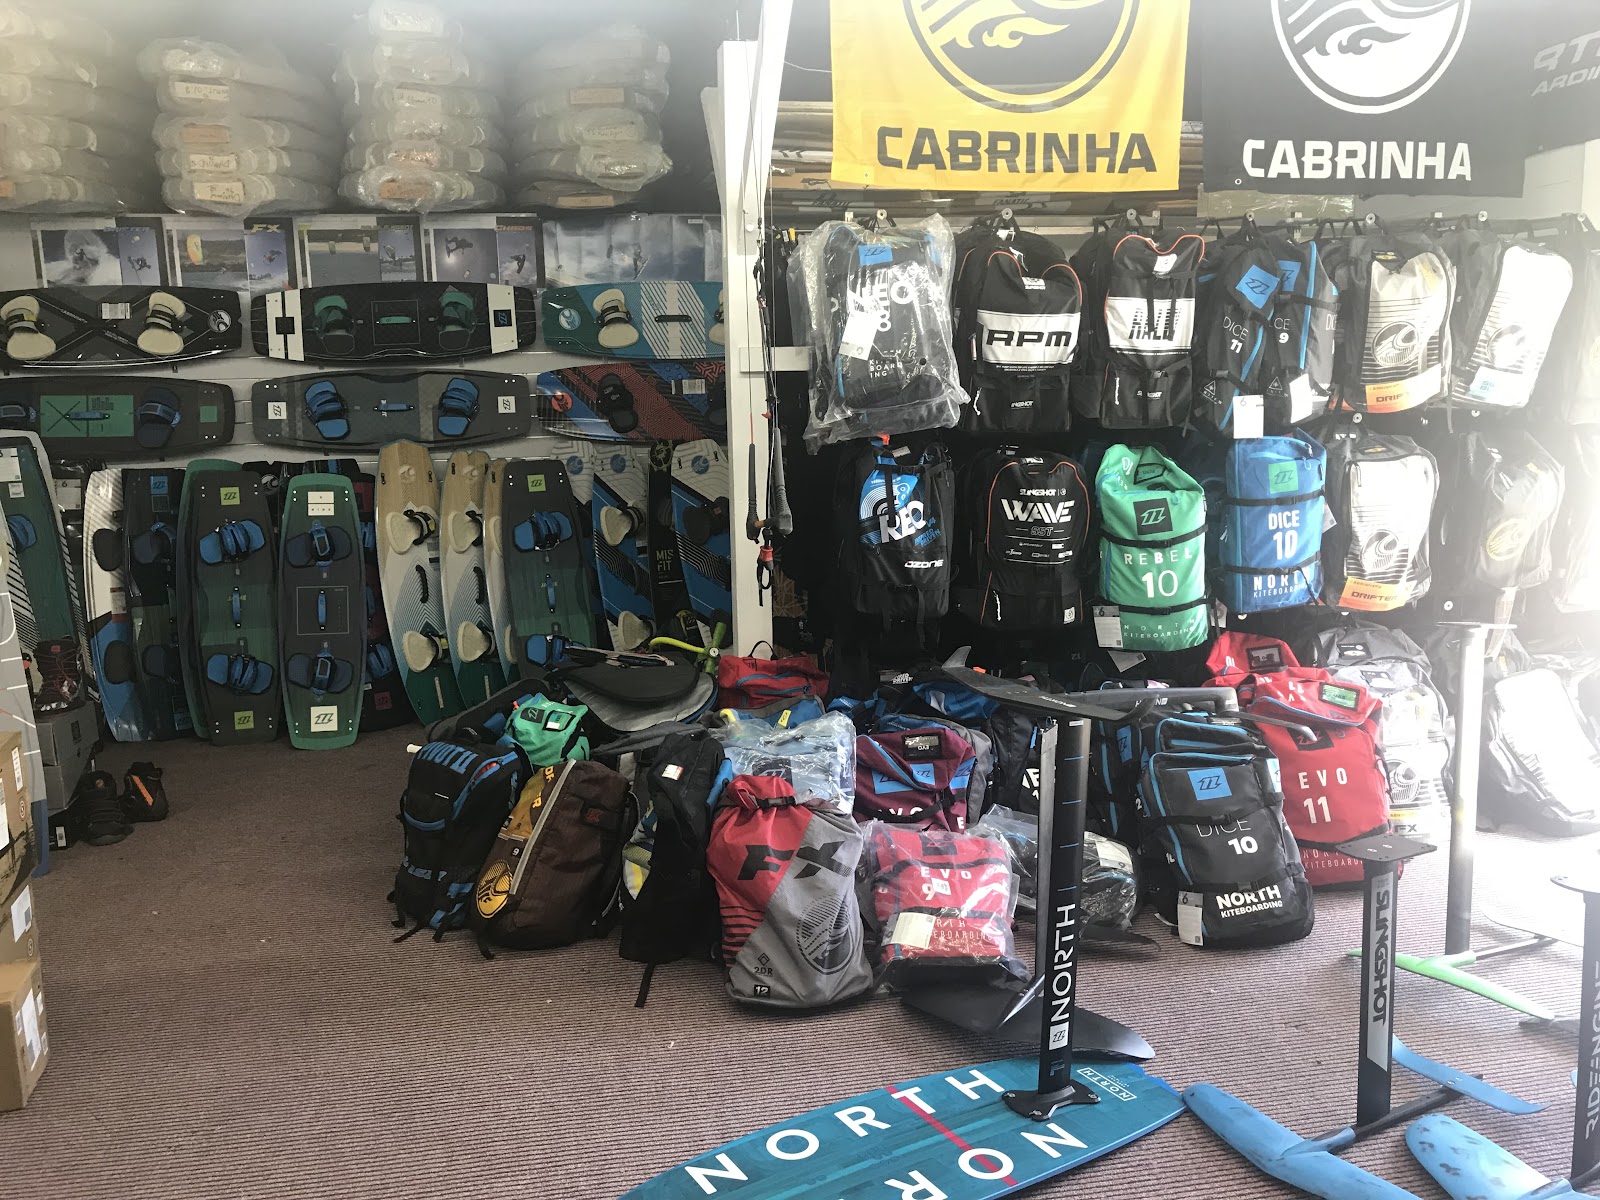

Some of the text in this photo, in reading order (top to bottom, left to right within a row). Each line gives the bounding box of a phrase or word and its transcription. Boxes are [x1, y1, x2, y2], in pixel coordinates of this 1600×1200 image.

[877, 126, 1157, 174] CABRINHA
[1242, 138, 1472, 182] CABRINHA
[250, 223, 281, 234] FX
[985, 329, 1072, 347] RPM
[1223, 316, 1249, 341] DICE
[1278, 332, 1290, 344] 9
[1229, 338, 1243, 354] 11
[1010, 400, 1034, 408] INGSHOT
[1019, 488, 1057, 497] SLINGSHOT
[1000, 498, 1075, 524] WAVE
[1268, 510, 1300, 530] DICE
[1272, 530, 1299, 561] 10
[655, 549, 674, 563] MIS
[904, 558, 945, 569] OZONE
[1124, 547, 1193, 566] REBEL
[656, 560, 673, 573] FIT
[1141, 569, 1179, 599] 10
[1124, 618, 1196, 631] NORTH
[1298, 767, 1348, 790] EVO
[1303, 796, 1332, 824] 11
[1227, 835, 1259, 855] 10
[737, 841, 856, 880] FX
[921, 866, 973, 880] EVO
[921, 882, 936, 901] 9
[1215, 884, 1282, 910] NORTH
[1220, 898, 1284, 919] KITEBOARDING
[936, 917, 967, 928] RTH
[931, 929, 993, 941] EBOARDING
[1049, 903, 1077, 1021] NORTH
[1372, 889, 1391, 1027] SLINGSHOT
[753, 967, 774, 976] 2DR
[754, 985, 771, 996] 12
[1082, 1068, 1133, 1100] NORTH
[684, 1069, 1006, 1195] NORTH
[837, 1121, 1089, 1200] NOR
